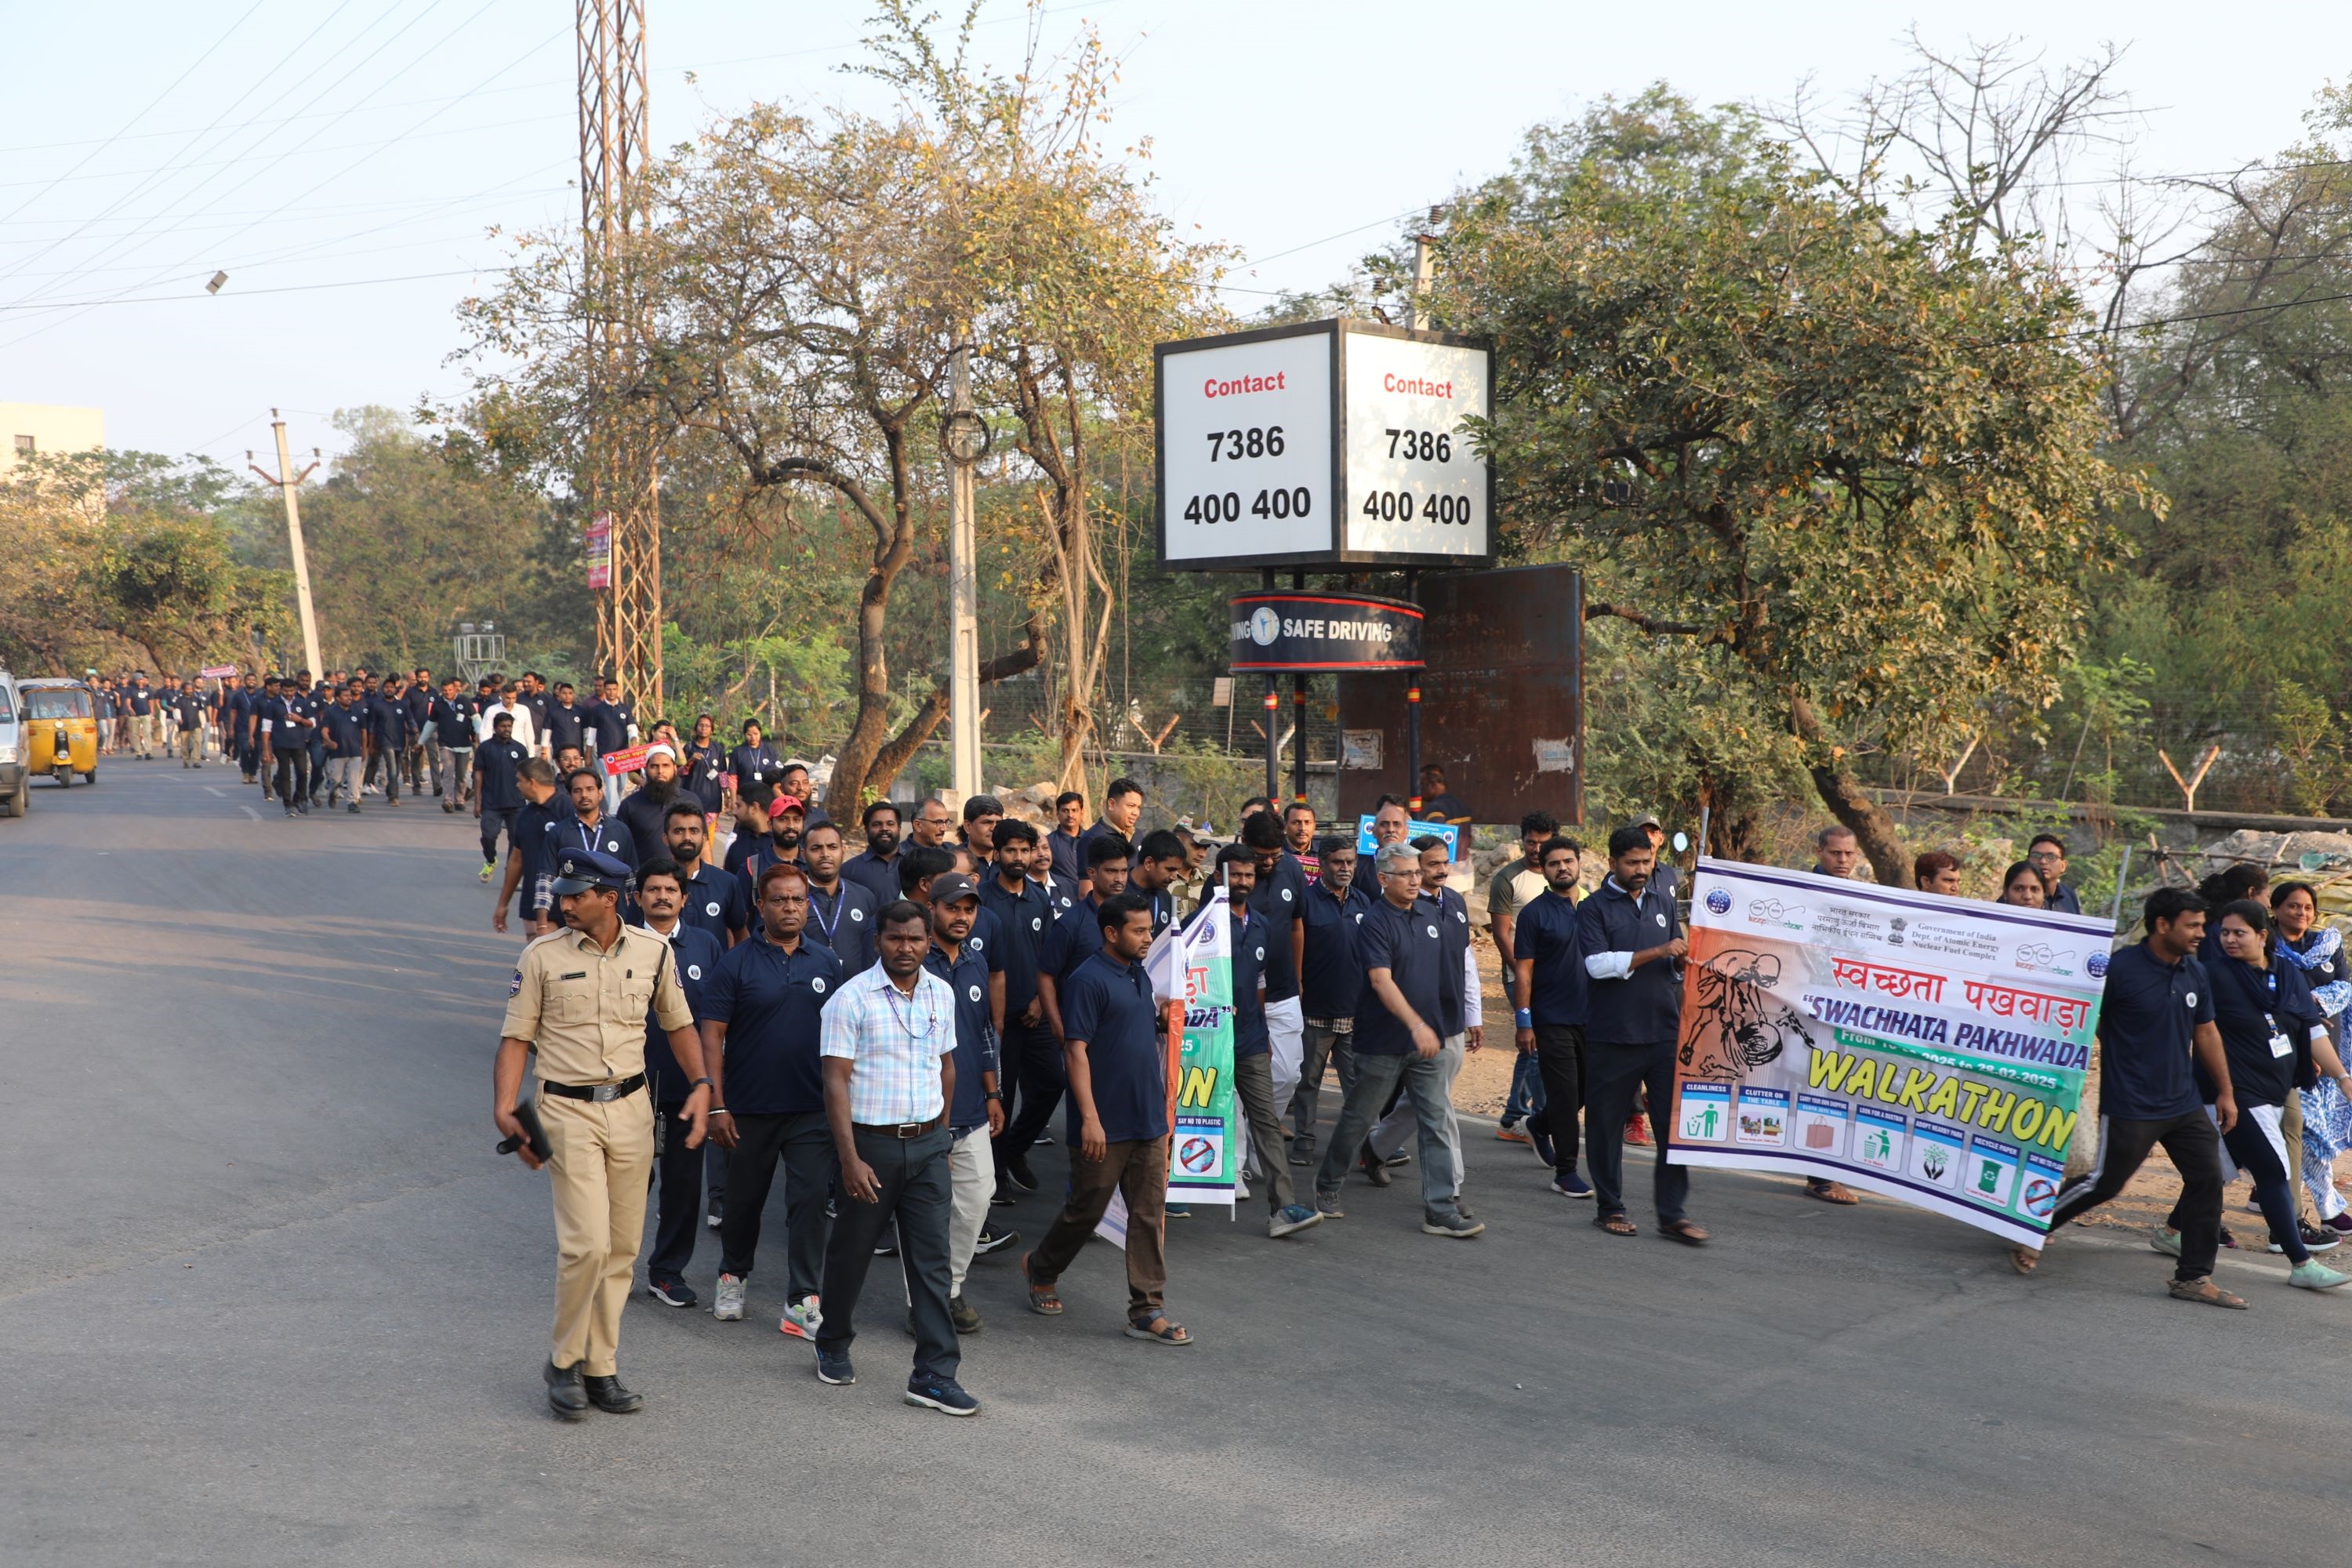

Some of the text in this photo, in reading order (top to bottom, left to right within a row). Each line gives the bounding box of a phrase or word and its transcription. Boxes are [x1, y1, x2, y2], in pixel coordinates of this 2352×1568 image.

[1204, 371, 1285, 398] Contact
[1384, 372, 1453, 398] Contact
[1207, 425, 1285, 463] 7386
[1385, 428, 1451, 463] 7386
[1184, 487, 1311, 524] 400 400
[1363, 490, 1471, 524] 400 400
[1283, 619, 1392, 643] SAFE DRIVING
[1911, 931, 1932, 941] Dept.
[1943, 937, 1970, 947] Atomic
[1972, 941, 2000, 953] Energy
[1918, 922, 1965, 936] Government
[1976, 932, 1997, 942] India
[1911, 941, 1996, 960] Nuclear Fuel Complex
[1831, 956, 2092, 1037] स्वच्छता पखवाड़ा
[1841, 1029, 1876, 1046] From
[1953, 1022, 2090, 1071] PAKHWADA
[1177, 1065, 1218, 1108] N
[1686, 1083, 1726, 1092] CLEANLINESS
[1745, 1089, 1773, 1098] CLUTTER
[1808, 1047, 2077, 1152] WALKATHON
[1859, 1106, 1871, 1115] LOOK
[1915, 1120, 1963, 1138] ADOPT NEARBY PARK
[1974, 1136, 2017, 1156] RECYCLE PAPER
